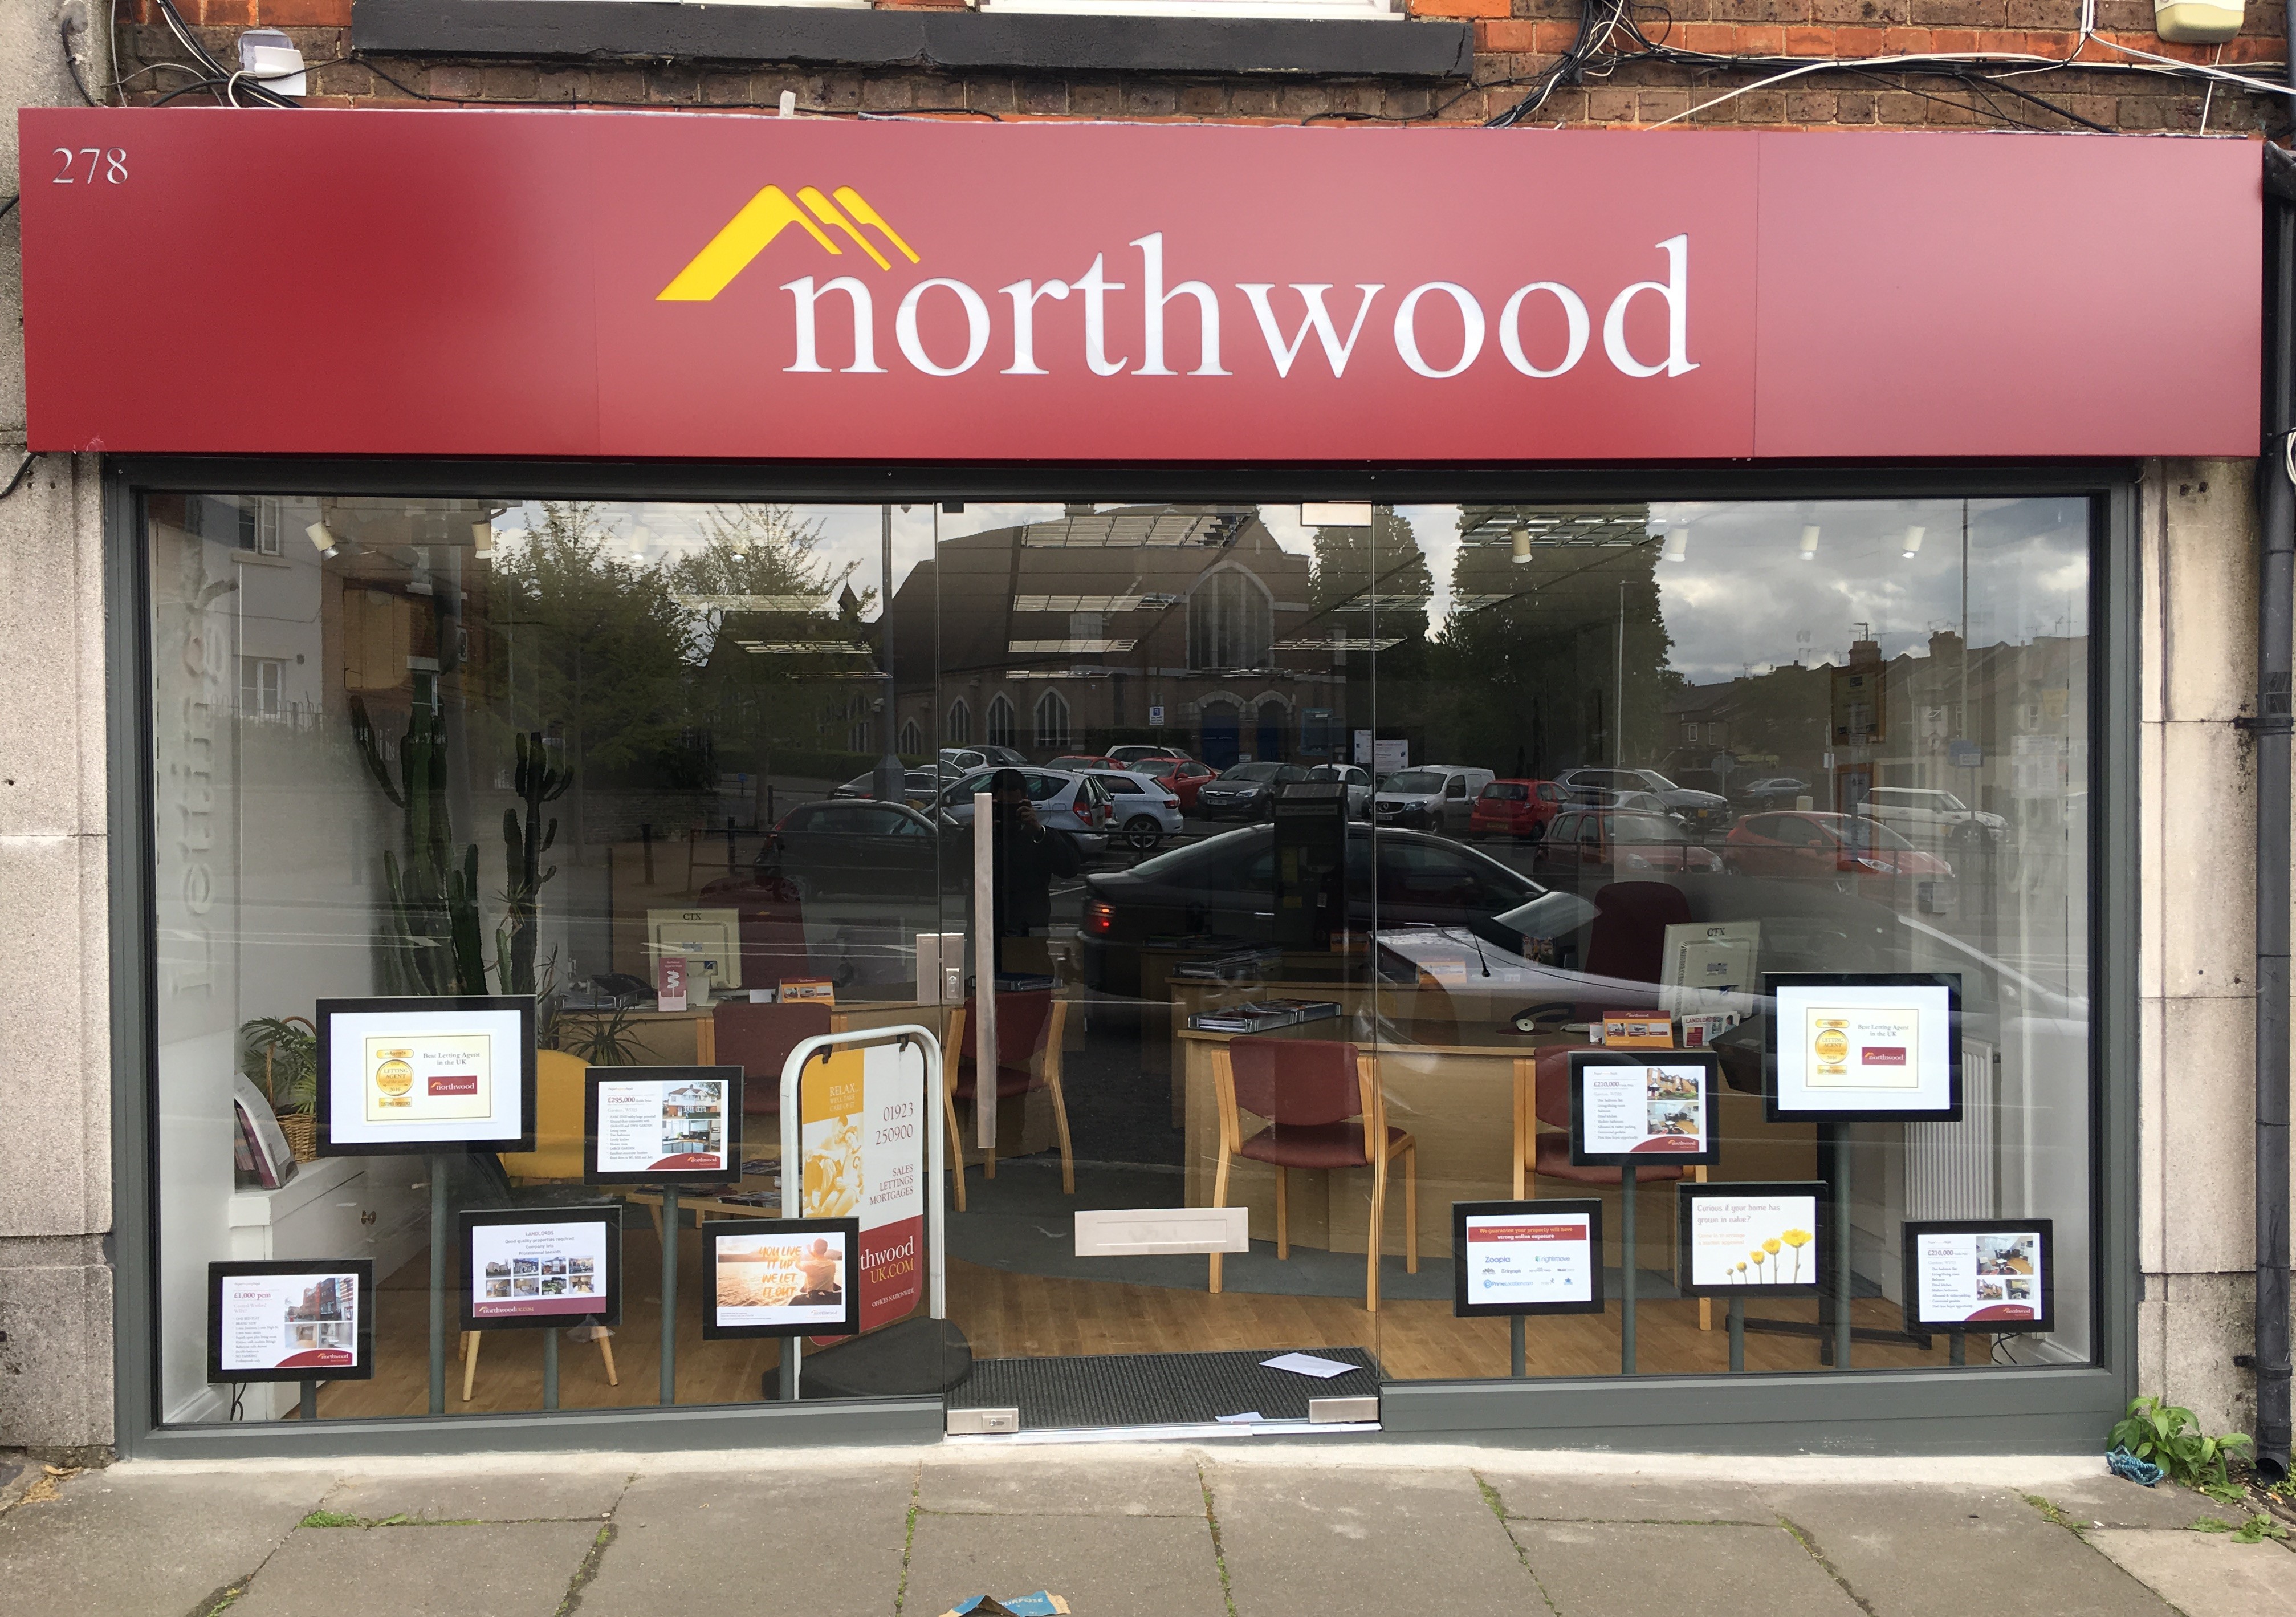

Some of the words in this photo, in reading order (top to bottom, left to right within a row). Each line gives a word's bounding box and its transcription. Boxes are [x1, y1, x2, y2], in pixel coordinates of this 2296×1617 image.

[52, 147, 128, 184] 278
[779, 231, 1701, 379] northwood
[1707, 928, 1725, 936] CTX
[884, 1102, 913, 1122] 01923
[876, 1123, 913, 1145] 250900
[893, 1164, 913, 1177] SALES
[880, 1175, 913, 1192] LETTINGS
[870, 1186, 913, 1205] MORTGAGES
[1697, 1217, 1719, 1225] grown
[759, 1246, 780, 1257] YOU
[781, 1246, 802, 1256] LIVE
[860, 1235, 914, 1270] thwood
[767, 1259, 778, 1269] IT
[870, 1258, 914, 1283] UK.COM
[762, 1273, 777, 1283] WE
[780, 1273, 798, 1283] LET
[763, 1287, 774, 1298] IT
[775, 1286, 797, 1297] OUT
[872, 1297, 889, 1307] OFFICES
[888, 1287, 914, 1301] NATIONWIDE
